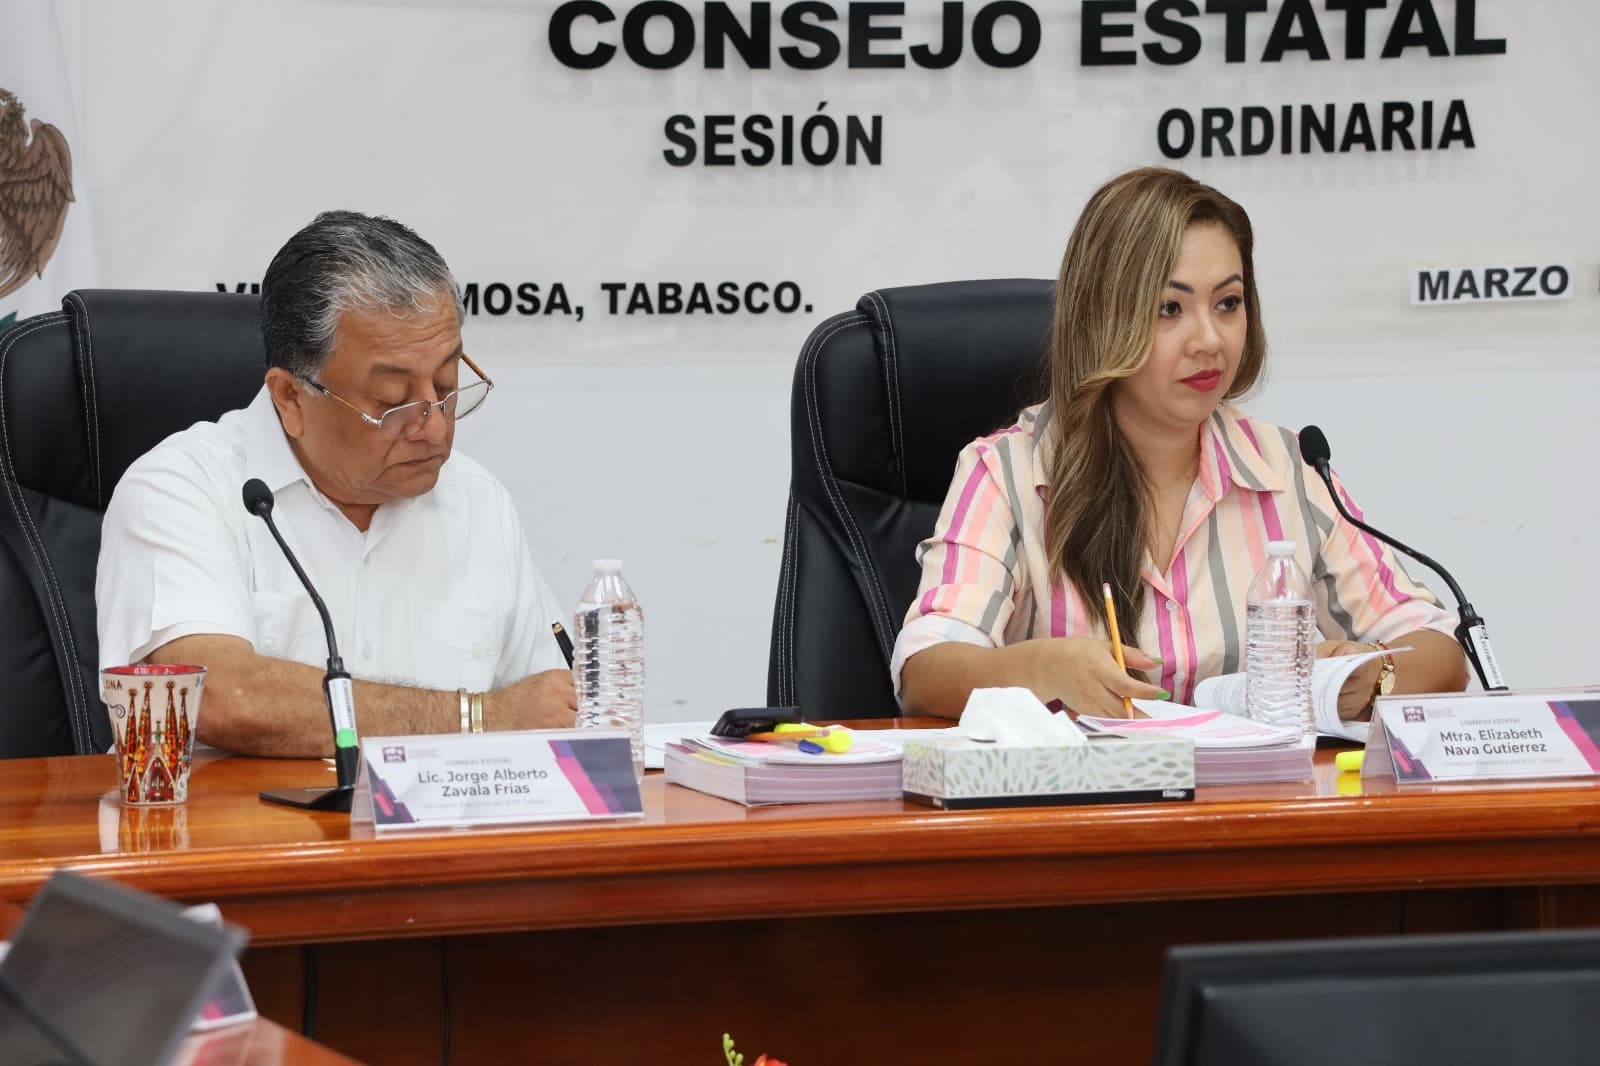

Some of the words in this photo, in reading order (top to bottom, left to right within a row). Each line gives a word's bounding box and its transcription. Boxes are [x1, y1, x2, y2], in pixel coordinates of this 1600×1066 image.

[548, 0, 1041, 70] CONSEJO
[1081, 0, 1507, 67] ESTATAL
[663, 101, 883, 167] SESIÓN
[1157, 99, 1476, 159] ORDINARIA
[1419, 265, 1569, 302] MARZO
[601, 281, 813, 315] TABASCO.
[1440, 730, 1476, 742] Mtra.
[1479, 727, 1543, 742] Elizabeth
[1444, 744, 1480, 756] Nava
[418, 770, 443, 784] Lic.
[447, 769, 489, 785] Jorge
[493, 768, 548, 780] Alberto
[441, 784, 491, 797] Zavala
